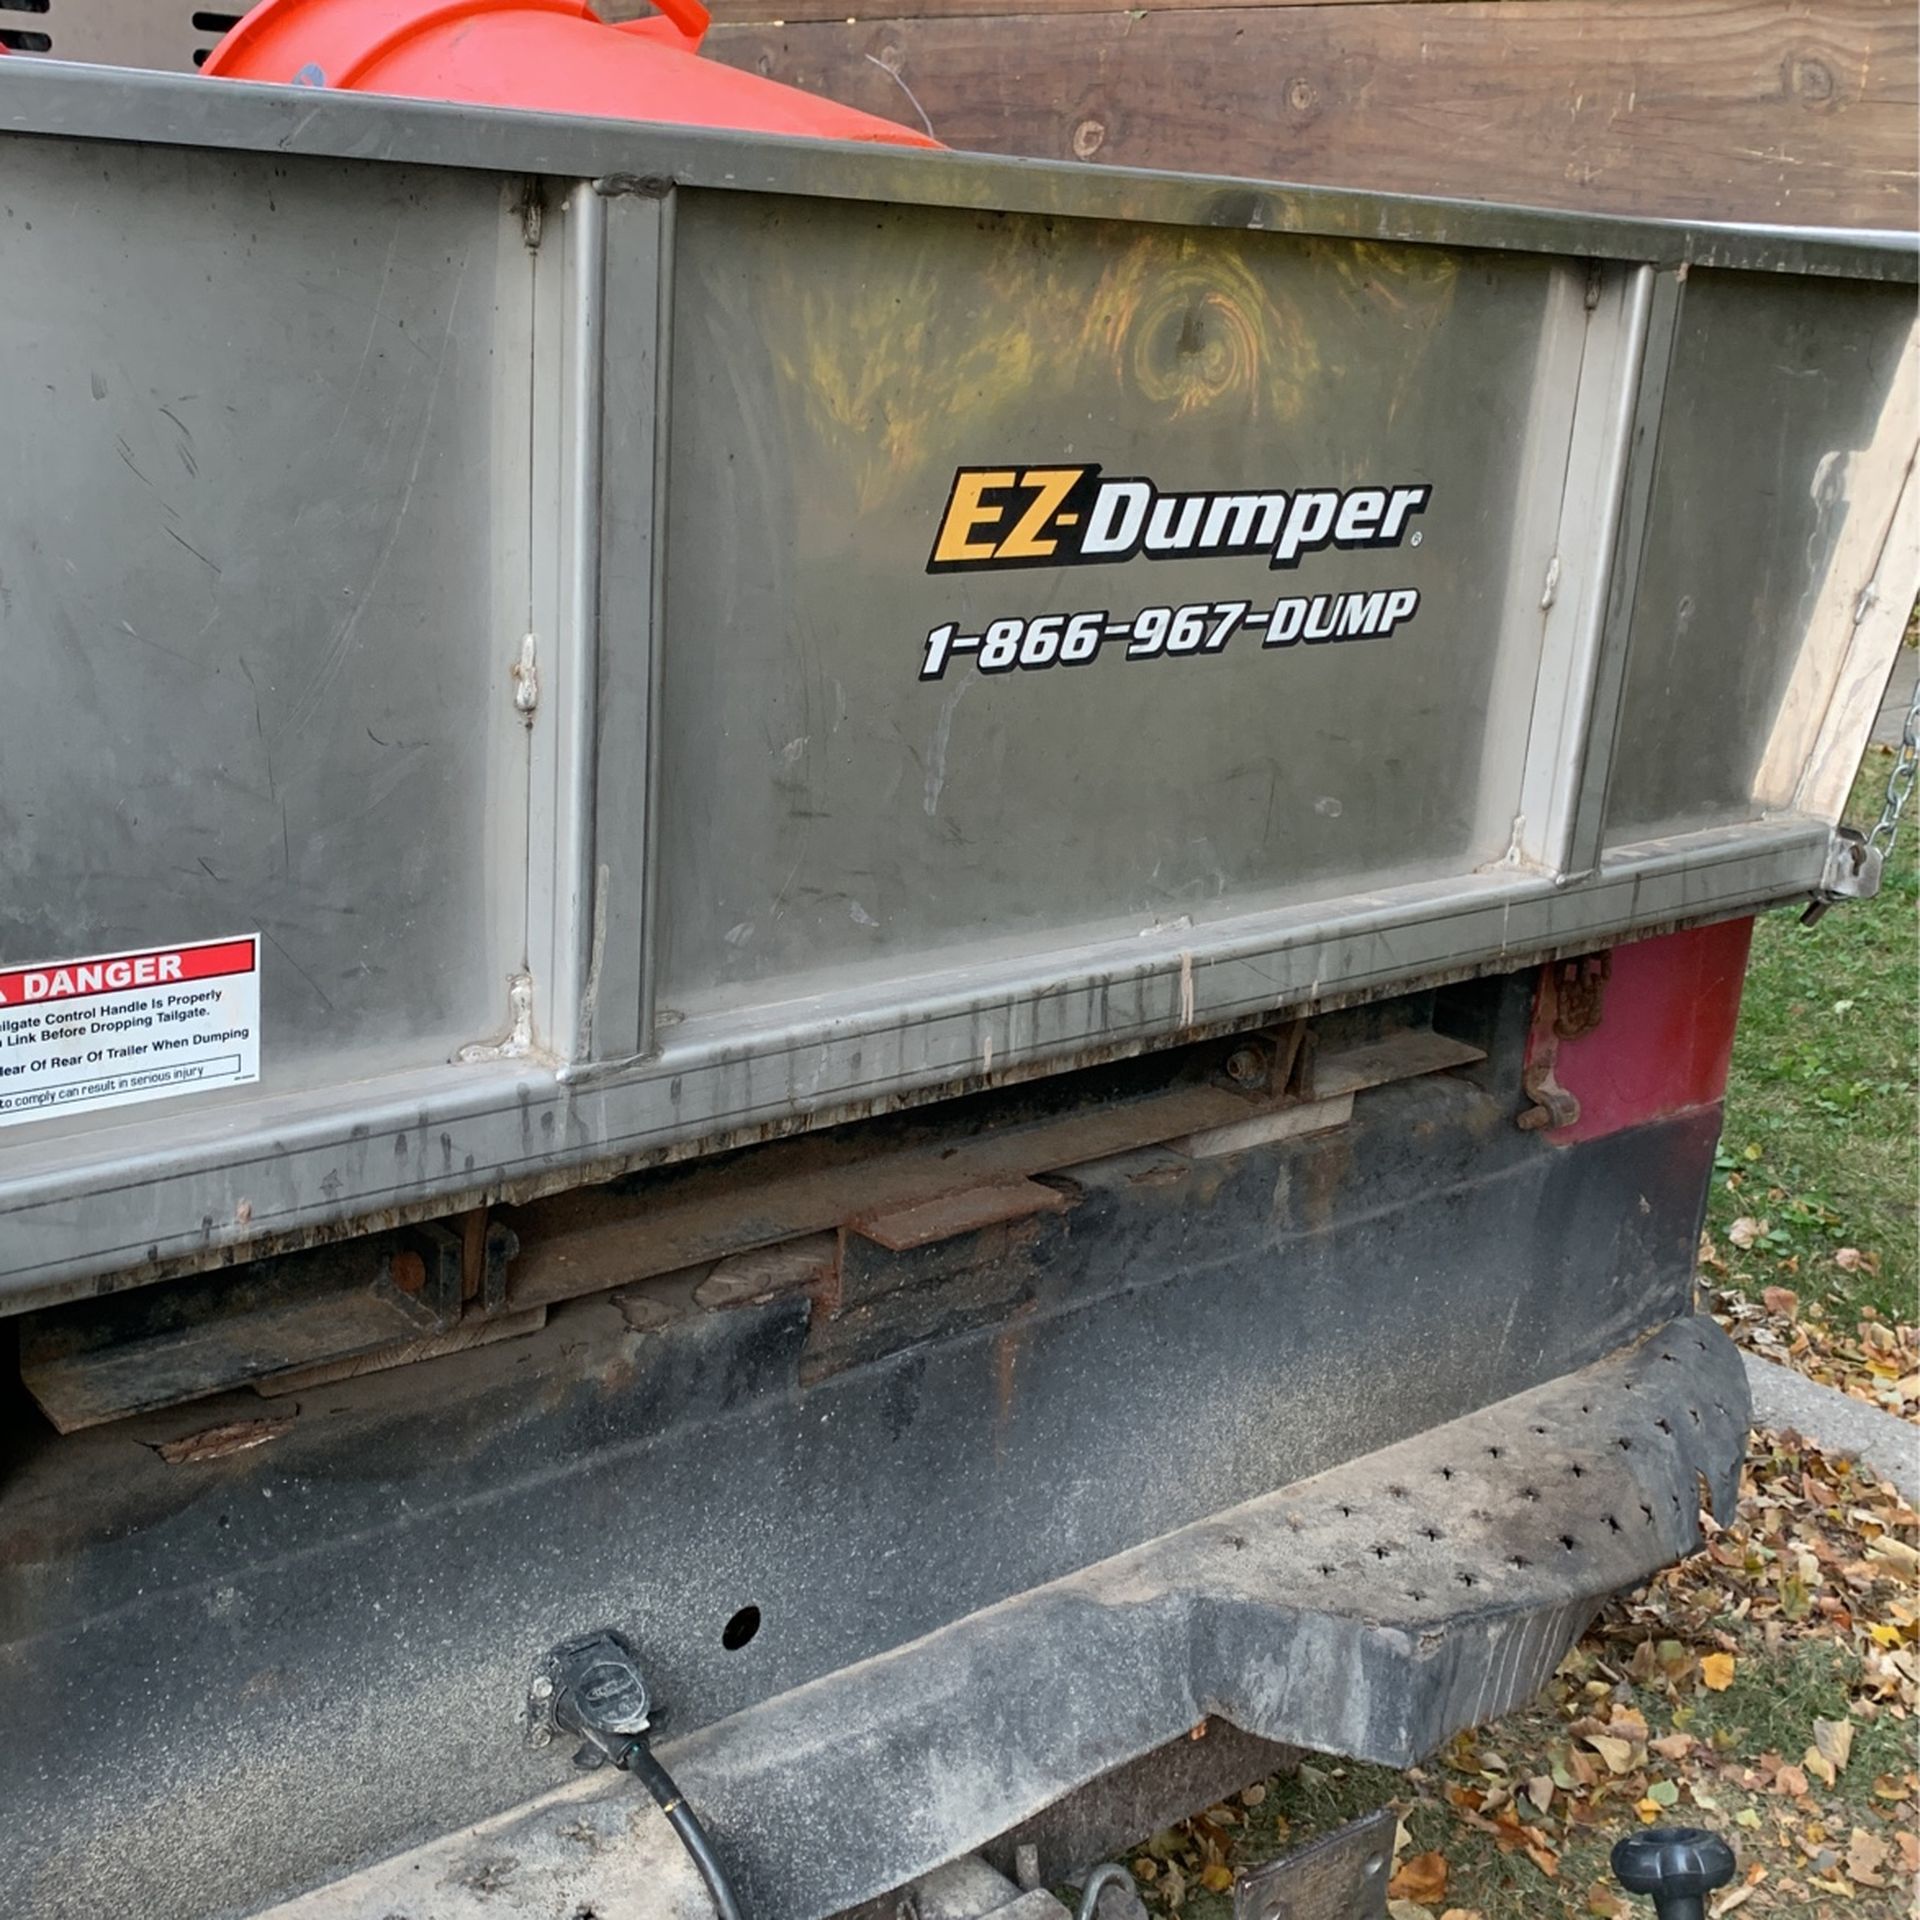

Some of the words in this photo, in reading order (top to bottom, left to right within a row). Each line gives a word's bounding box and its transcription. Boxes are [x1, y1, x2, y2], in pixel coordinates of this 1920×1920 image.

[931, 467, 1428, 562] EZ-Dumper
[921, 589, 1420, 677] 1-866-967-DUMP
[23, 955, 183, 1001] DANGER
[0, 1017, 41, 1033] ilgate
[45, 1008, 96, 1025] Control
[100, 1000, 148, 1017] Handle
[151, 998, 164, 1010] Is
[168, 988, 222, 1008] Properly
[7, 1032, 37, 1047] Link
[41, 1026, 87, 1042] Before
[90, 1015, 153, 1034] Dropping
[157, 1006, 210, 1024] Tailgate.
[0, 1064, 26, 1077] lear
[30, 1058, 47, 1072] Of
[51, 1055, 83, 1069] Rear
[86, 1050, 103, 1063] Of
[106, 1043, 148, 1060] Trailer
[151, 1036, 189, 1052] When
[193, 1028, 250, 1046] Dumping
[0, 1098, 13, 1110] to
[14, 1090, 57, 1106] comply
[58, 1086, 80, 1100] can
[81, 1080, 116, 1096] result
[118, 1078, 129, 1089] in
[130, 1071, 172, 1087] serious
[173, 1065, 205, 1081] injury
